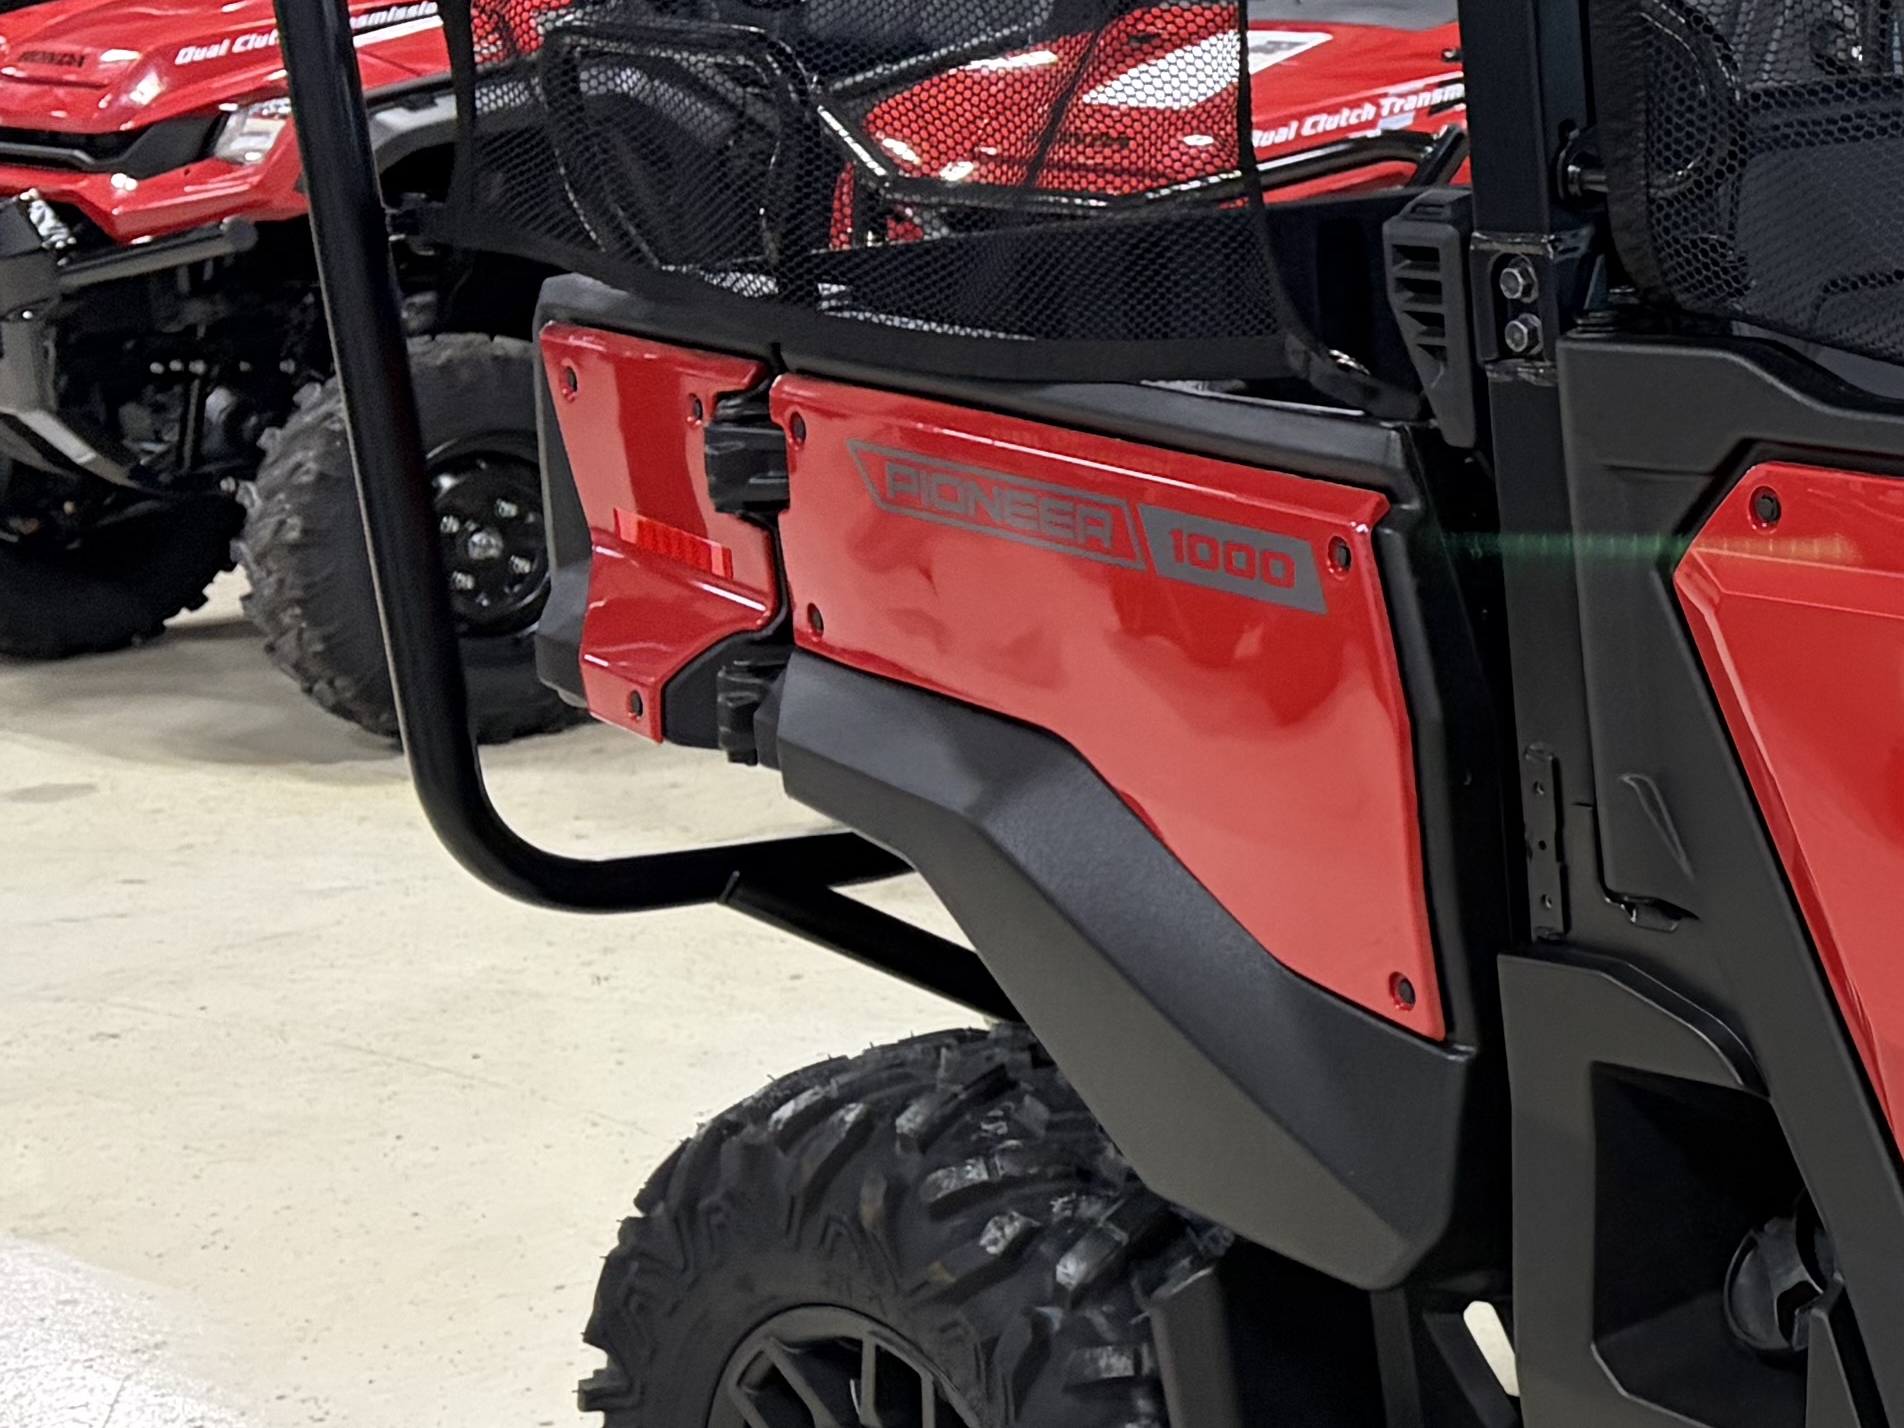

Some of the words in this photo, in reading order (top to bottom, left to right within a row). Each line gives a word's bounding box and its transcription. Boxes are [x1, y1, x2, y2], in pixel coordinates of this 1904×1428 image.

[231, 28, 280, 54] Clut
[1300, 102, 1377, 138] Clutch
[1378, 82, 1466, 117] Transm
[884, 461, 1114, 550] PIONEER
[1167, 528, 1297, 590] 1000
